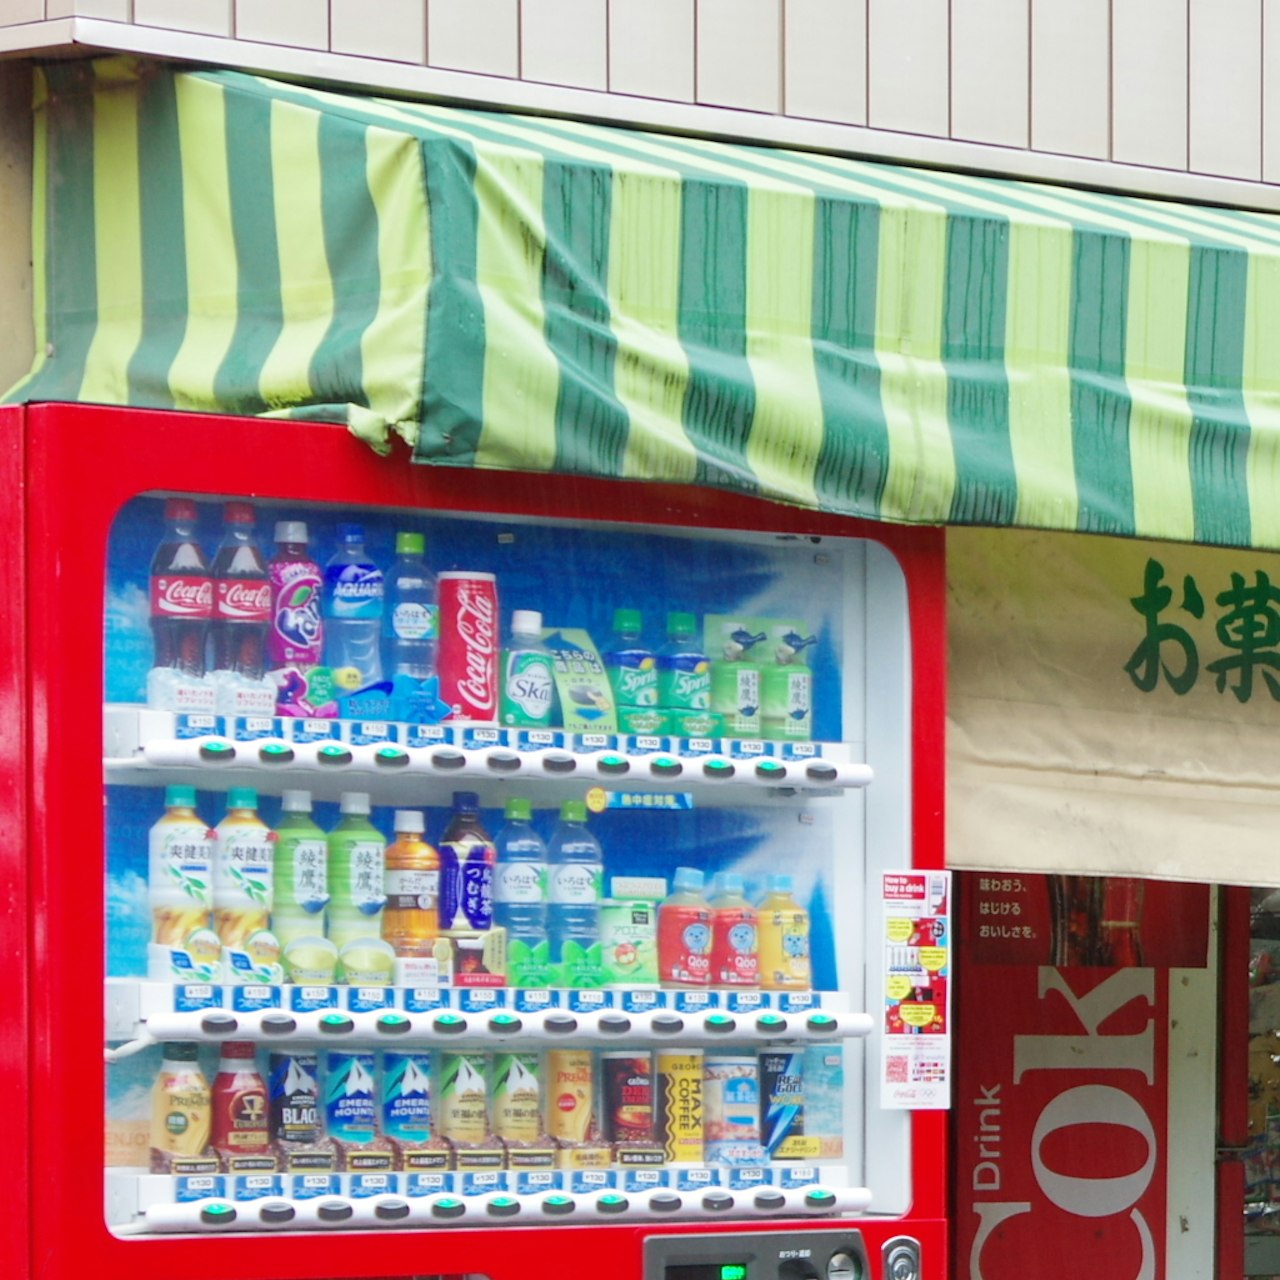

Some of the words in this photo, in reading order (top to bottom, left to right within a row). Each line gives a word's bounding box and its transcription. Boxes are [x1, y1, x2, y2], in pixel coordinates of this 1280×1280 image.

[456, 586, 494, 711] Coca-Cola
[979, 877, 1028, 893] 味わおう、
[979, 902, 1021, 916] はじける
[979, 924, 1037, 940] おいしさを。
[687, 955, 709, 969] Qoo
[735, 956, 757, 969] Qoo
[679, 1078, 690, 1130] COFFEE
[690, 1078, 703, 1130] MAX
[972, 1083, 1001, 1191] Drink
